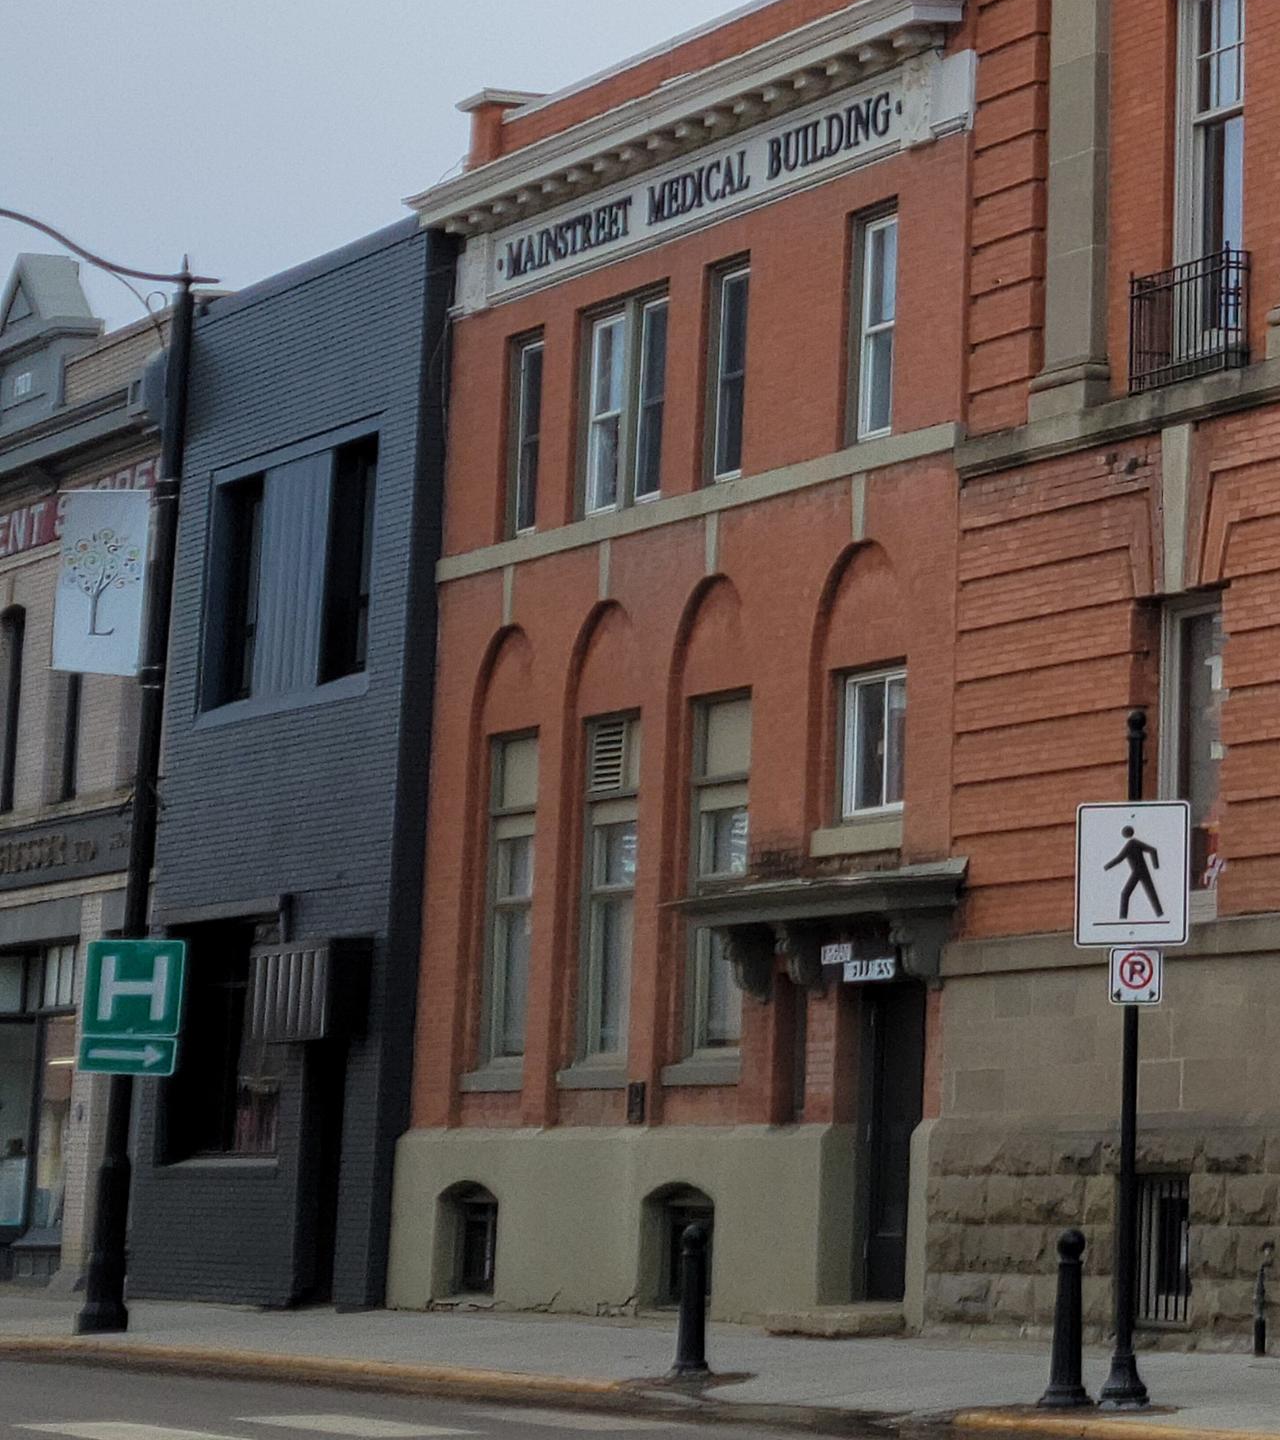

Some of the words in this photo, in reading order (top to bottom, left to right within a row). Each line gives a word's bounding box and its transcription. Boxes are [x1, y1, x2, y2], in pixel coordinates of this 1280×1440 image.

[506, 195, 632, 280] MAINSTREET
[646, 150, 750, 226] MEDICAL
[766, 91, 891, 181] BUILDING
[97, 955, 169, 1020] H
[1128, 960, 1146, 982] P
